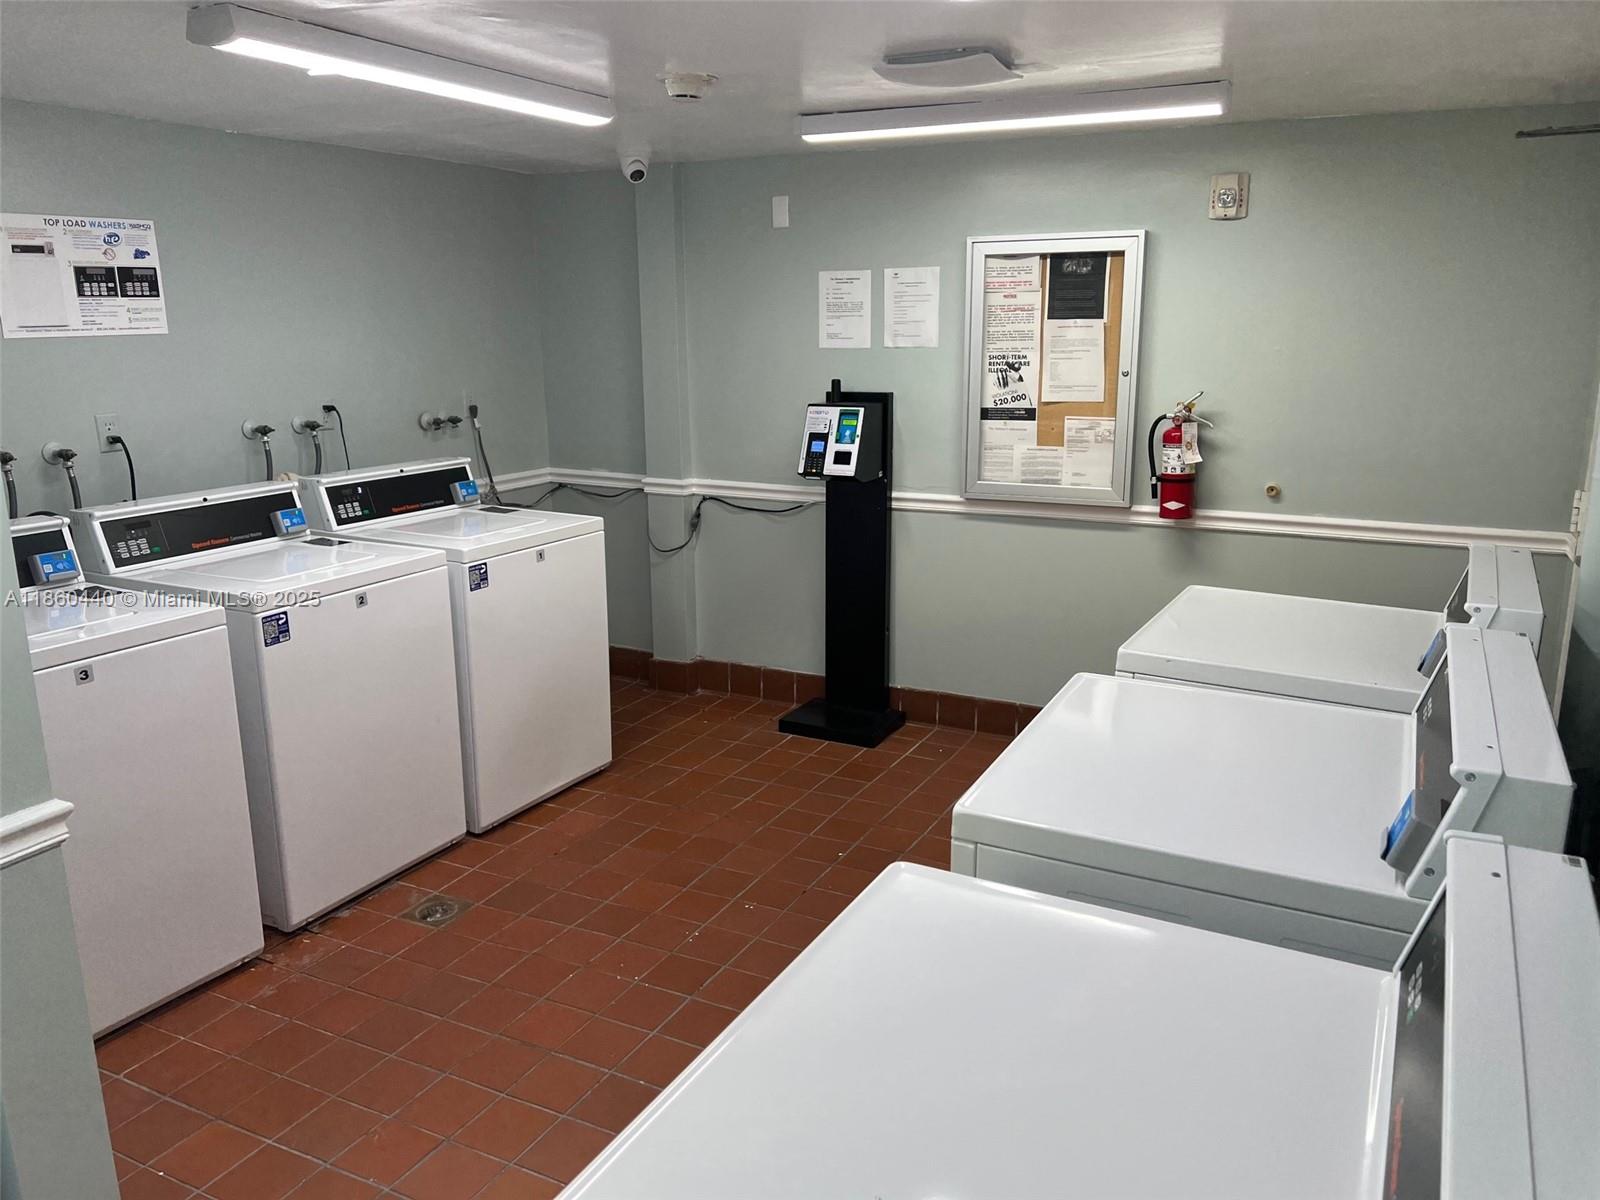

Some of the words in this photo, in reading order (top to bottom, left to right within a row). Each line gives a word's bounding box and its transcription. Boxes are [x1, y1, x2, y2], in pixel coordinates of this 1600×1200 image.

[43, 218, 60, 227] TOP
[63, 219, 87, 228] LOAD
[89, 220, 126, 230] WASHERS
[993, 393, 1027, 407] $20,000
[538, 552, 543, 560] 1
[358, 595, 365, 605] 2
[79, 669, 90, 681] 3
